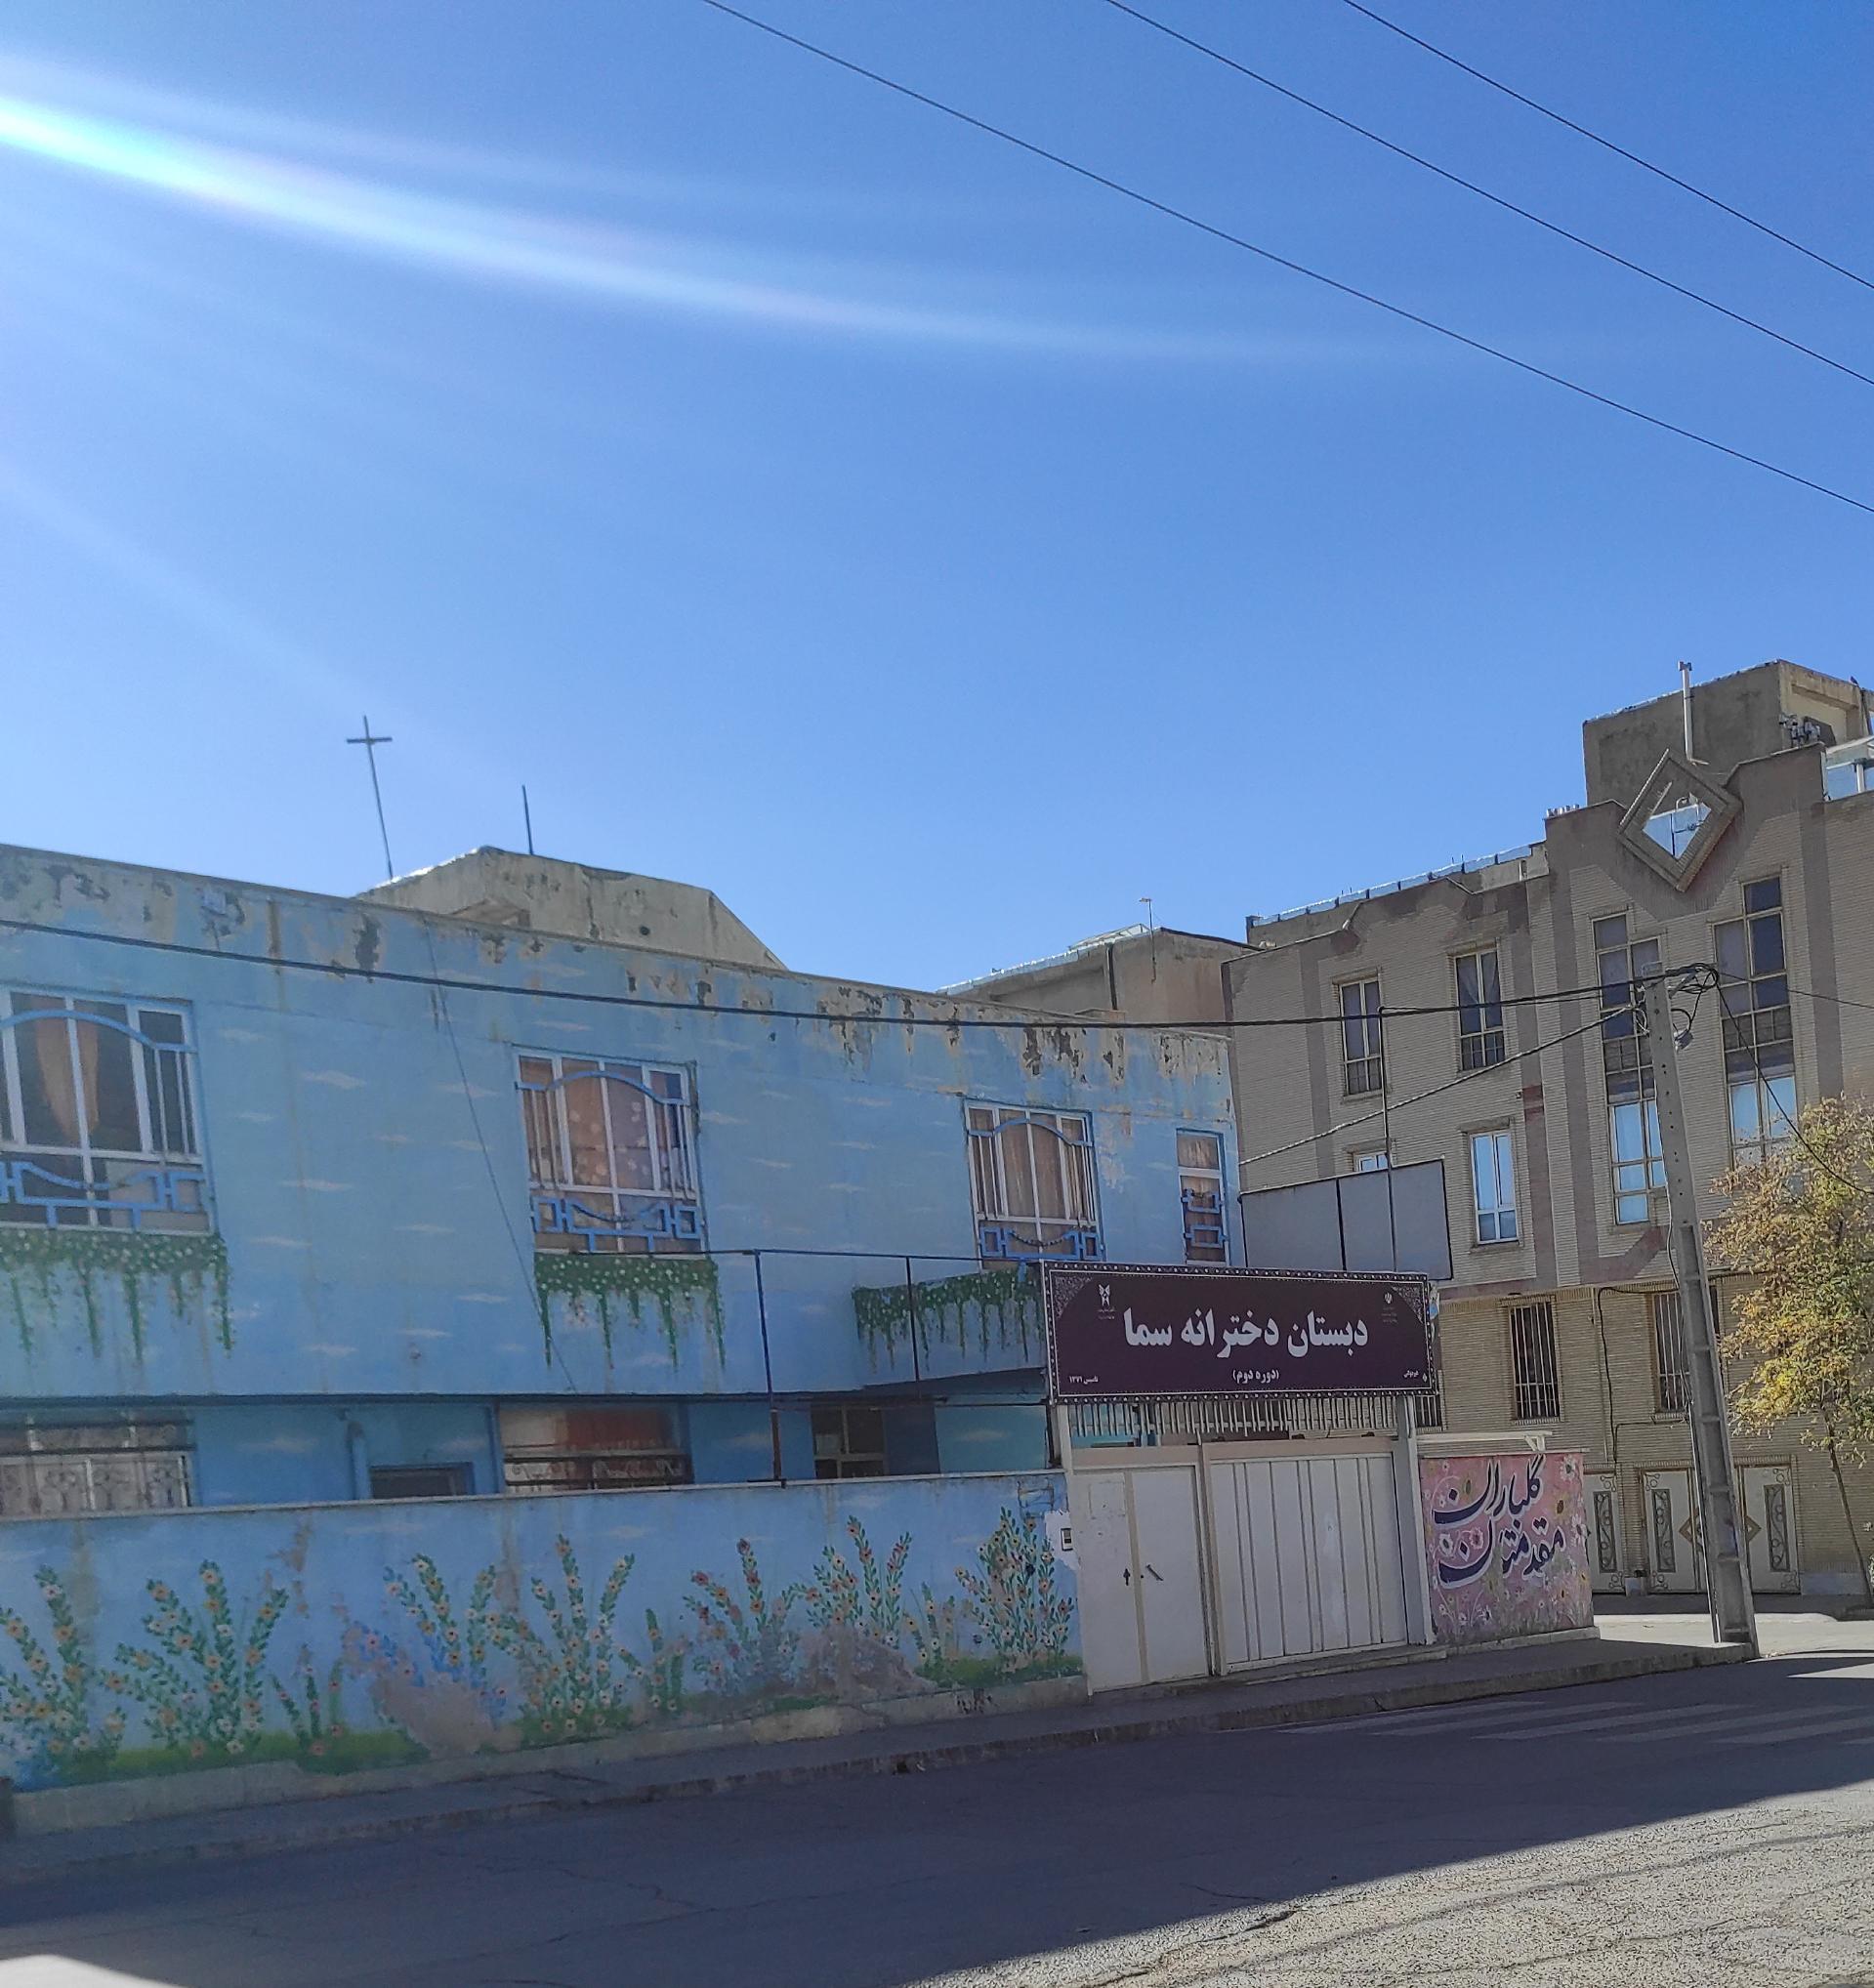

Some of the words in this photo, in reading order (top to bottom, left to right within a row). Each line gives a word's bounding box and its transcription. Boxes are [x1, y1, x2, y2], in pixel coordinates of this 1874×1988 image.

[1123, 1306, 1172, 1346] سما
[1181, 1307, 1279, 1358] دخترانه
[1287, 1309, 1368, 1357] دبستان
[1232, 1369, 1254, 1384] دوم)
[1255, 1369, 1279, 1384] (دوره
[1432, 1455, 1546, 1530] گلباران
